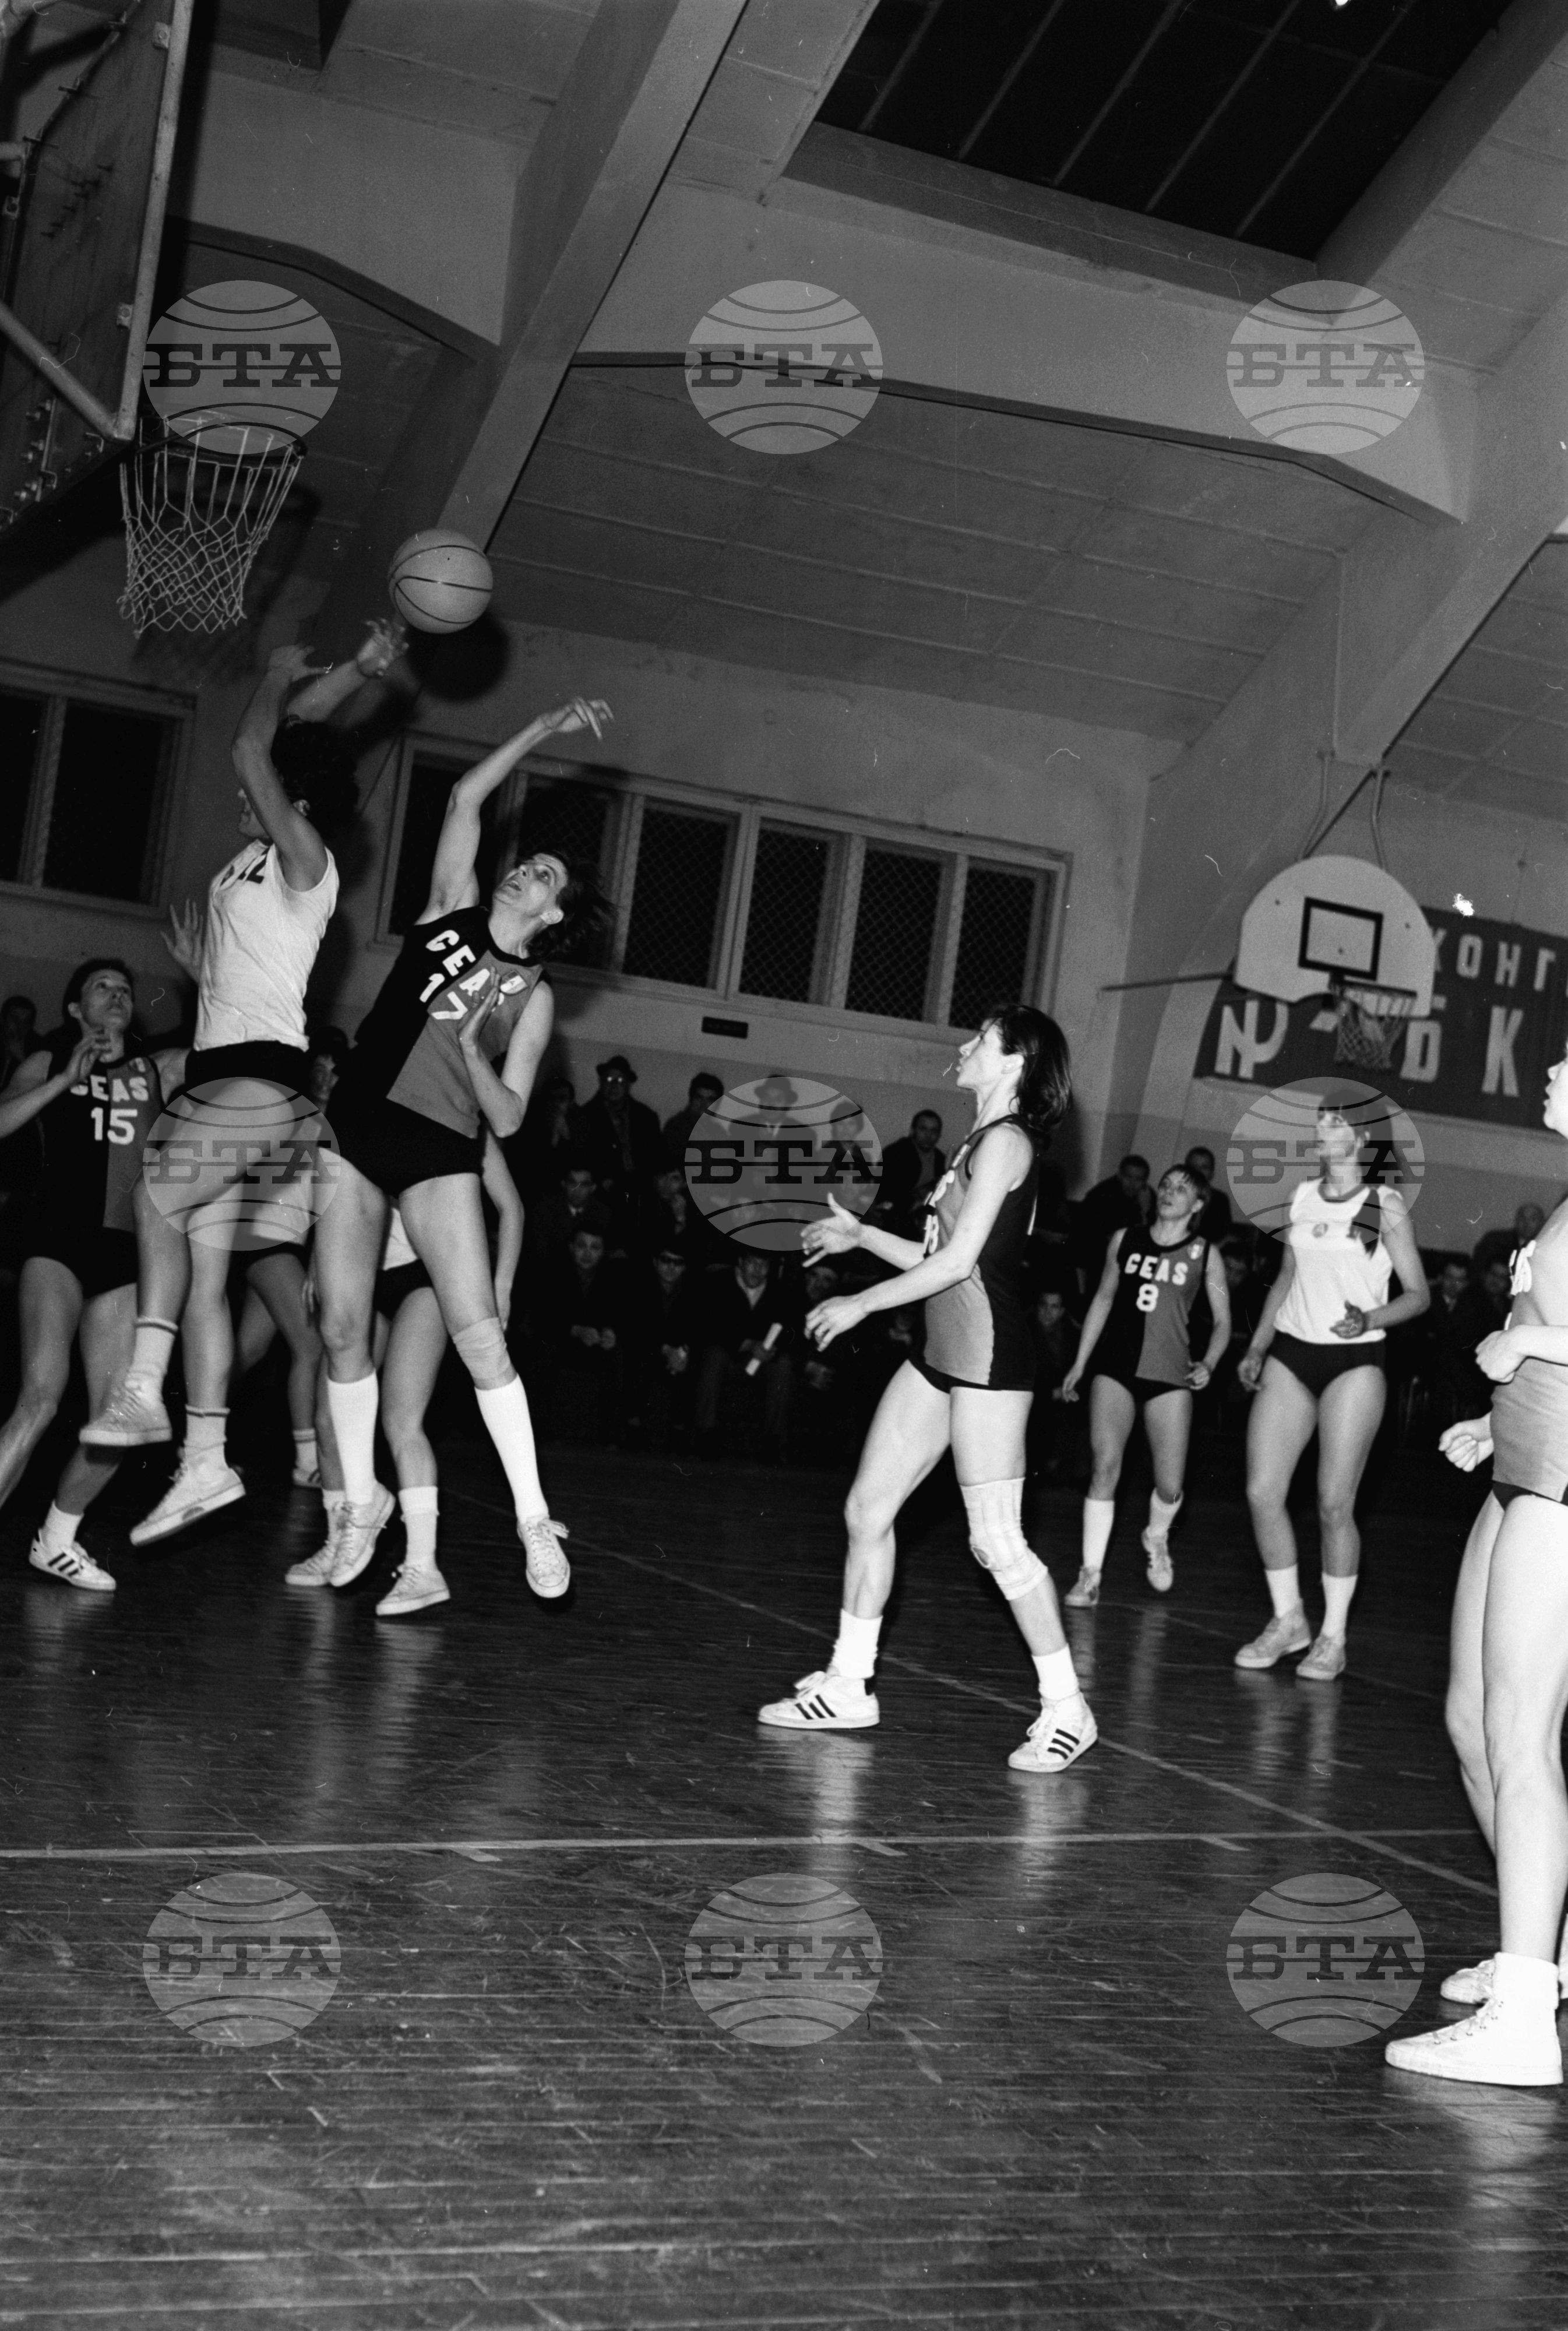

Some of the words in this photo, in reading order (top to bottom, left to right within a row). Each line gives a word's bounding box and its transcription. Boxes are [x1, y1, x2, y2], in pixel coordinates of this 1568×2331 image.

[420, 973, 468, 1019] 17
[91, 1107, 138, 1145] 15
[1136, 1283, 1159, 1312] 8
